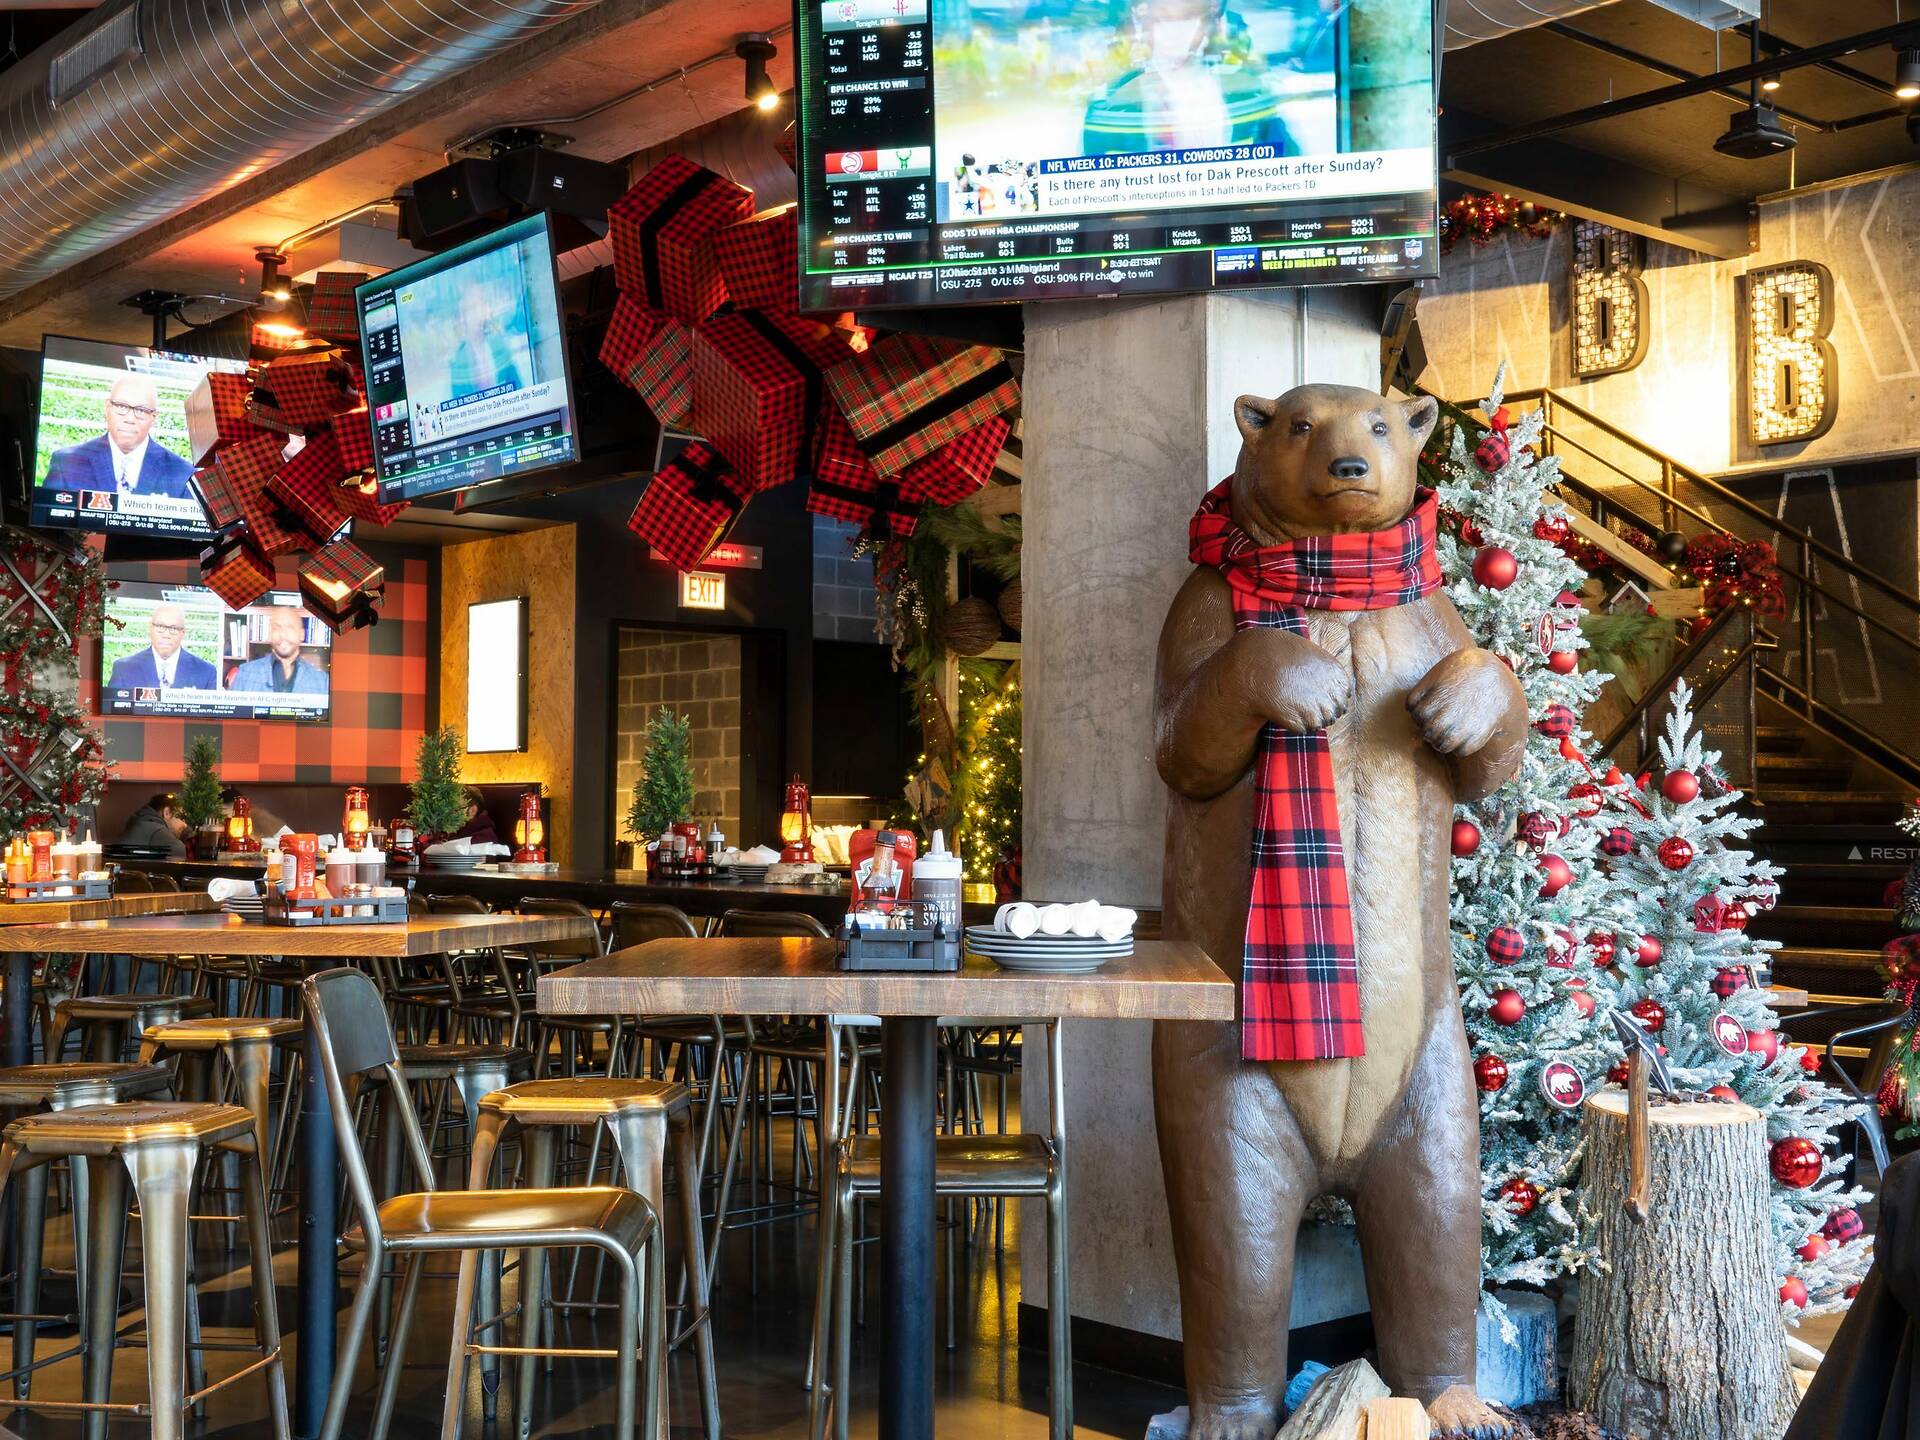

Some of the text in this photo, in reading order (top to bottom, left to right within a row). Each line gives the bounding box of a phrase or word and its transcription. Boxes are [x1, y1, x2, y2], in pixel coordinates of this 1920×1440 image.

[862, 35, 877, 43] LAC
[907, 31, 922, 39] -5.5
[830, 85, 844, 93] BPI
[845, 83, 879, 92] CHANCE
[892, 80, 909, 88] WIN
[1047, 146, 1274, 172] NFL WEEK 10: PACKERS 31, COWBOYS 28 (OT)
[1049, 157, 1383, 191] Is there any trust lost for Dak Prescott after Sunday?
[866, 187, 880, 195] MIL
[1049, 180, 1316, 206] Each of Prescott's interceptions in 1st half led to Packers TD
[833, 236, 848, 244] BPI
[849, 234, 882, 243] CHANCE
[896, 232, 912, 240] WIN
[942, 223, 1080, 238] ODDS TO WIN NBA CHAMPIONSHIP
[998, 241, 1015, 249] 60-1
[1172, 230, 1197, 238] Knicks
[1230, 226, 1251, 234] 150-1
[1291, 222, 1322, 231] Hornets
[1351, 219, 1373, 227] 500-1
[1113, 242, 1130, 250] 90-1
[1172, 238, 1202, 246] Wizards
[1230, 234, 1253, 242] 200-1
[1292, 232, 1313, 240] Kings
[1351, 227, 1374, 235] 500-1
[1262, 250, 1278, 260] NFL
[1262, 260, 1282, 270] WEEK
[1340, 256, 1358, 266] NOW
[1358, 254, 1398, 264] STREAMING
[918, 271, 933, 279] T25
[941, 269, 1154, 289] OSU -27.5 O/U: 65 OSU: 90% FPI to win
[1747, 259, 1839, 446] B
[124, 499, 153, 509] Which
[154, 503, 177, 512] team
[688, 576, 720, 603] EXIT
[1870, 847, 1920, 859] REST
